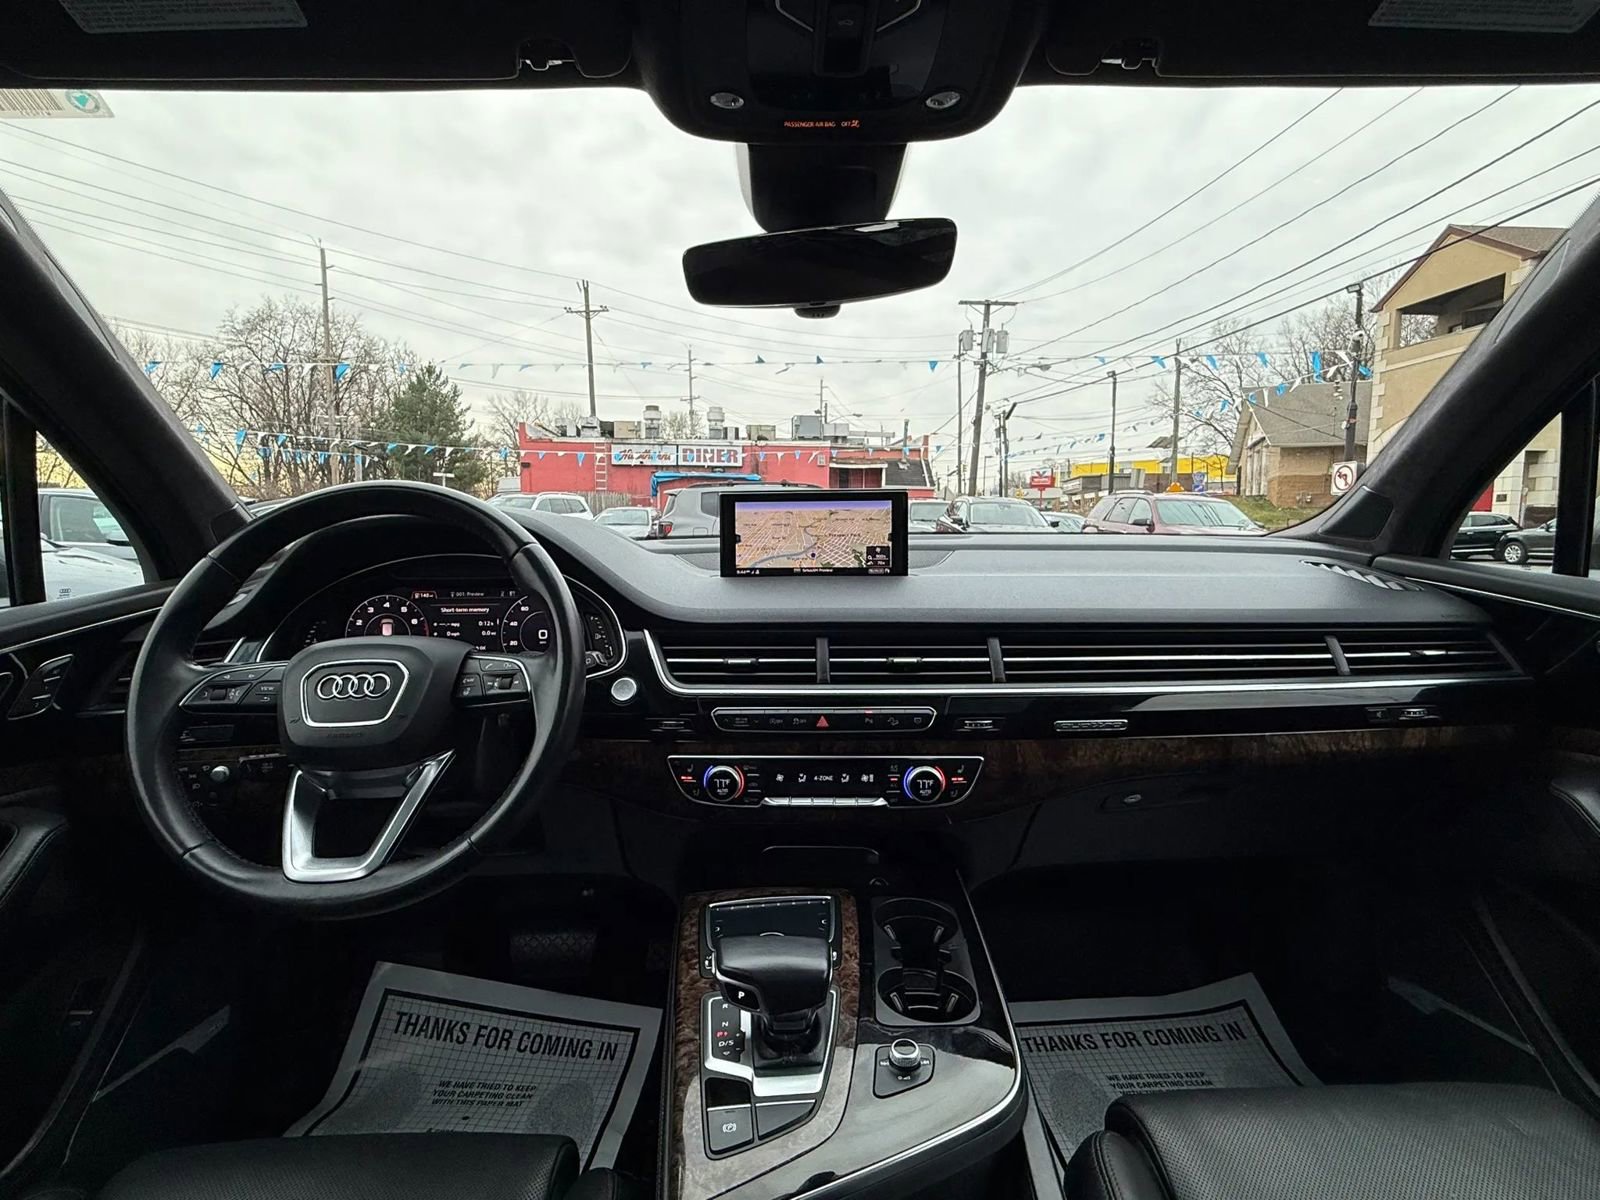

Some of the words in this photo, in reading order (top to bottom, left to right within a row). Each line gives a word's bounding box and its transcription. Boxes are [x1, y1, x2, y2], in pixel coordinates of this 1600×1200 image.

[682, 448, 738, 463] DINER
[538, 629, 548, 639] 0
[738, 991, 745, 999] P
[394, 1012, 470, 1045] THANKS
[473, 1025, 513, 1050] FOR
[517, 1031, 593, 1060] COMING
[597, 1042, 617, 1061] IN
[1021, 1033, 1098, 1053] THANKS
[1102, 1031, 1142, 1049] FOR
[1144, 1025, 1222, 1047] COMING
[1221, 1021, 1247, 1041] IN
[439, 1080, 453, 1088] WE
[453, 1081, 476, 1089] HAVE
[476, 1082, 502, 1090] TRIED
[433, 1089, 457, 1098] YOUR
[457, 1091, 503, 1099] CARPETING
